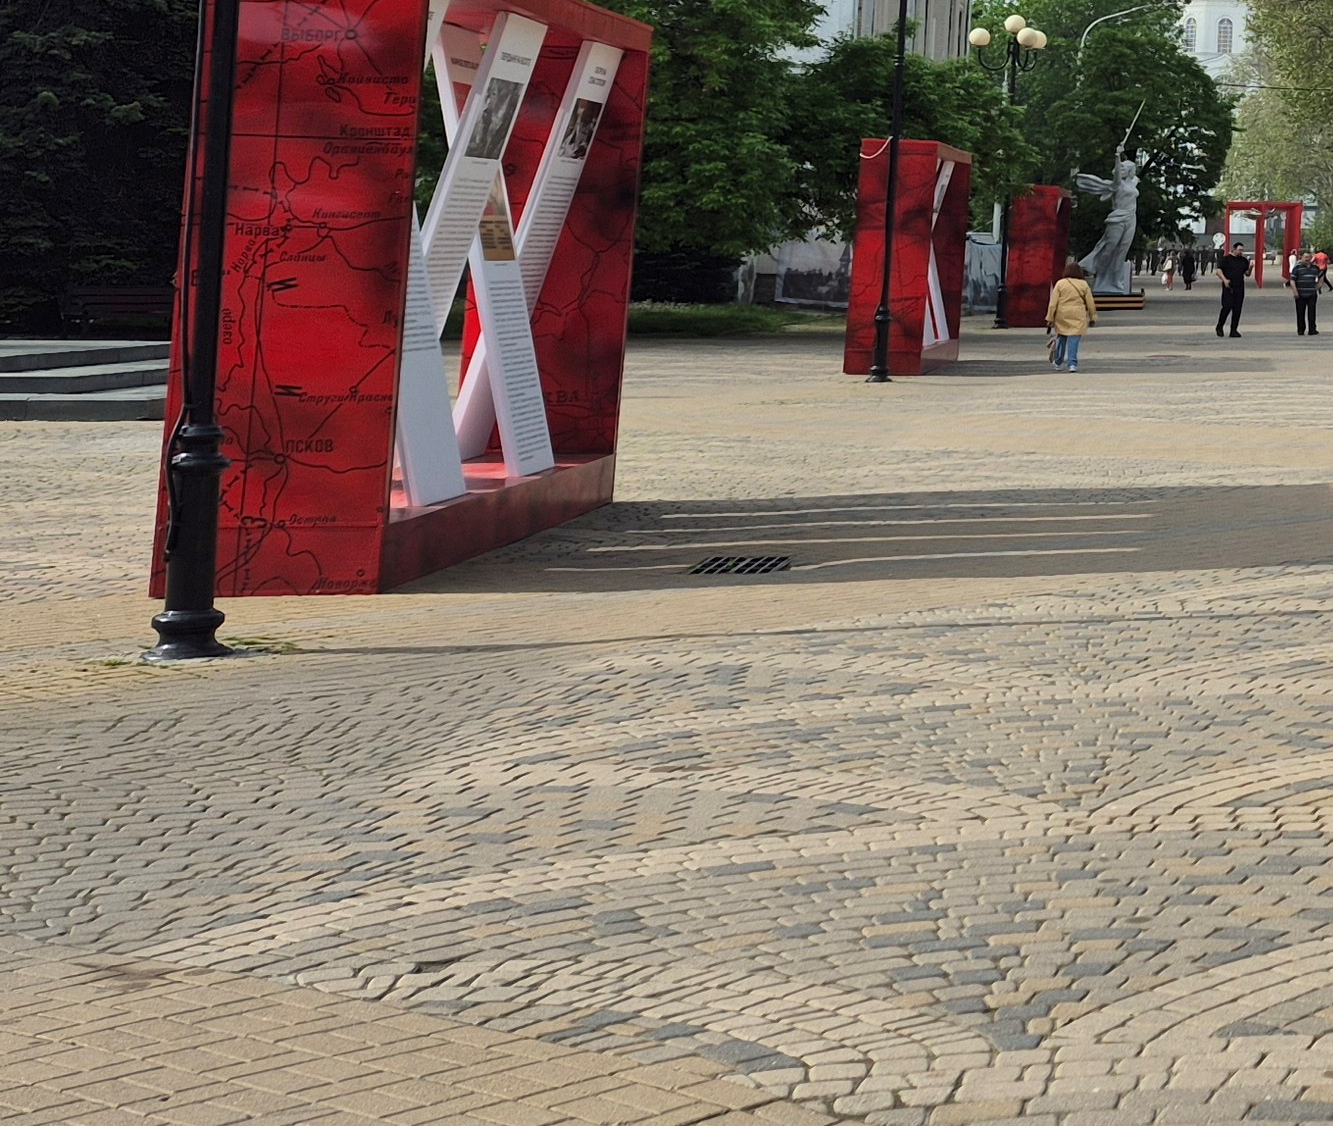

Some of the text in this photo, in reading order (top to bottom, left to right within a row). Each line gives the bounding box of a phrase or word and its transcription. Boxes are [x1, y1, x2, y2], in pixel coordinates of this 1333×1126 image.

[281, 27, 342, 42] ВЫБОРГ
[235, 224, 280, 239] Нарва
[286, 439, 334, 453] ПСКОВ
